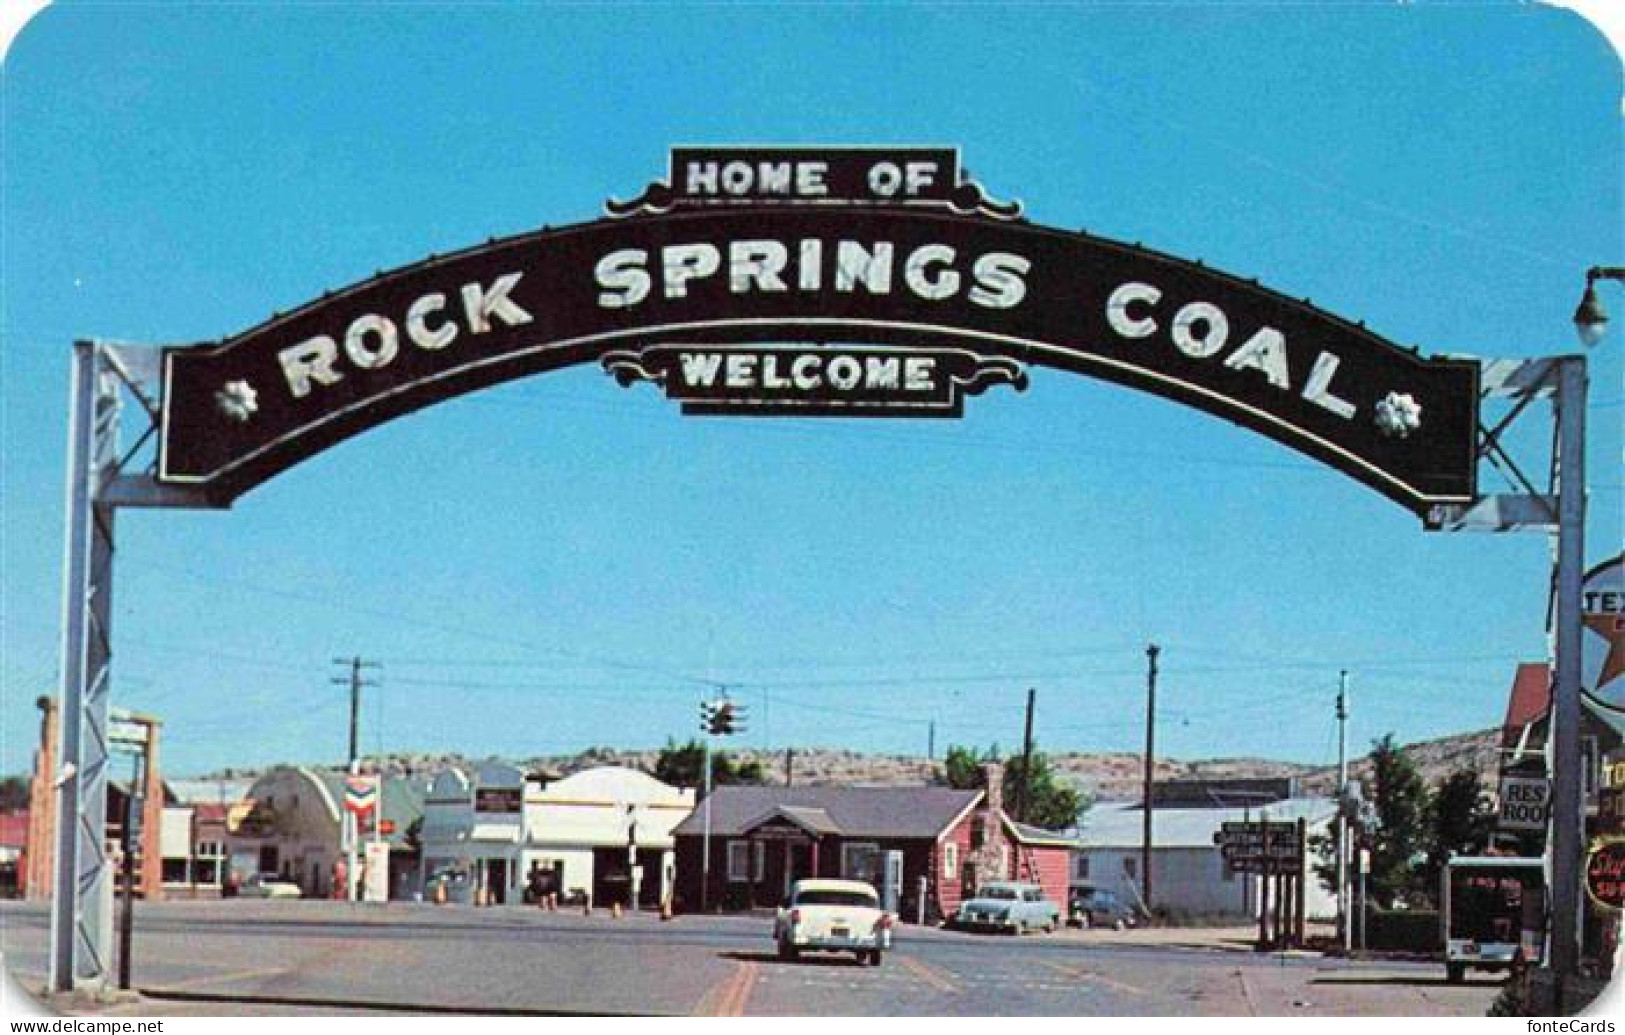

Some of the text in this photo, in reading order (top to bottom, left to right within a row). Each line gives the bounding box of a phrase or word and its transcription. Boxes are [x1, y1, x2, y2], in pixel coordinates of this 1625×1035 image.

[687, 161, 939, 195] HOME OF
[277, 238, 1357, 420] ROCK SPRINGS COAL
[679, 353, 936, 390] WELCOME
